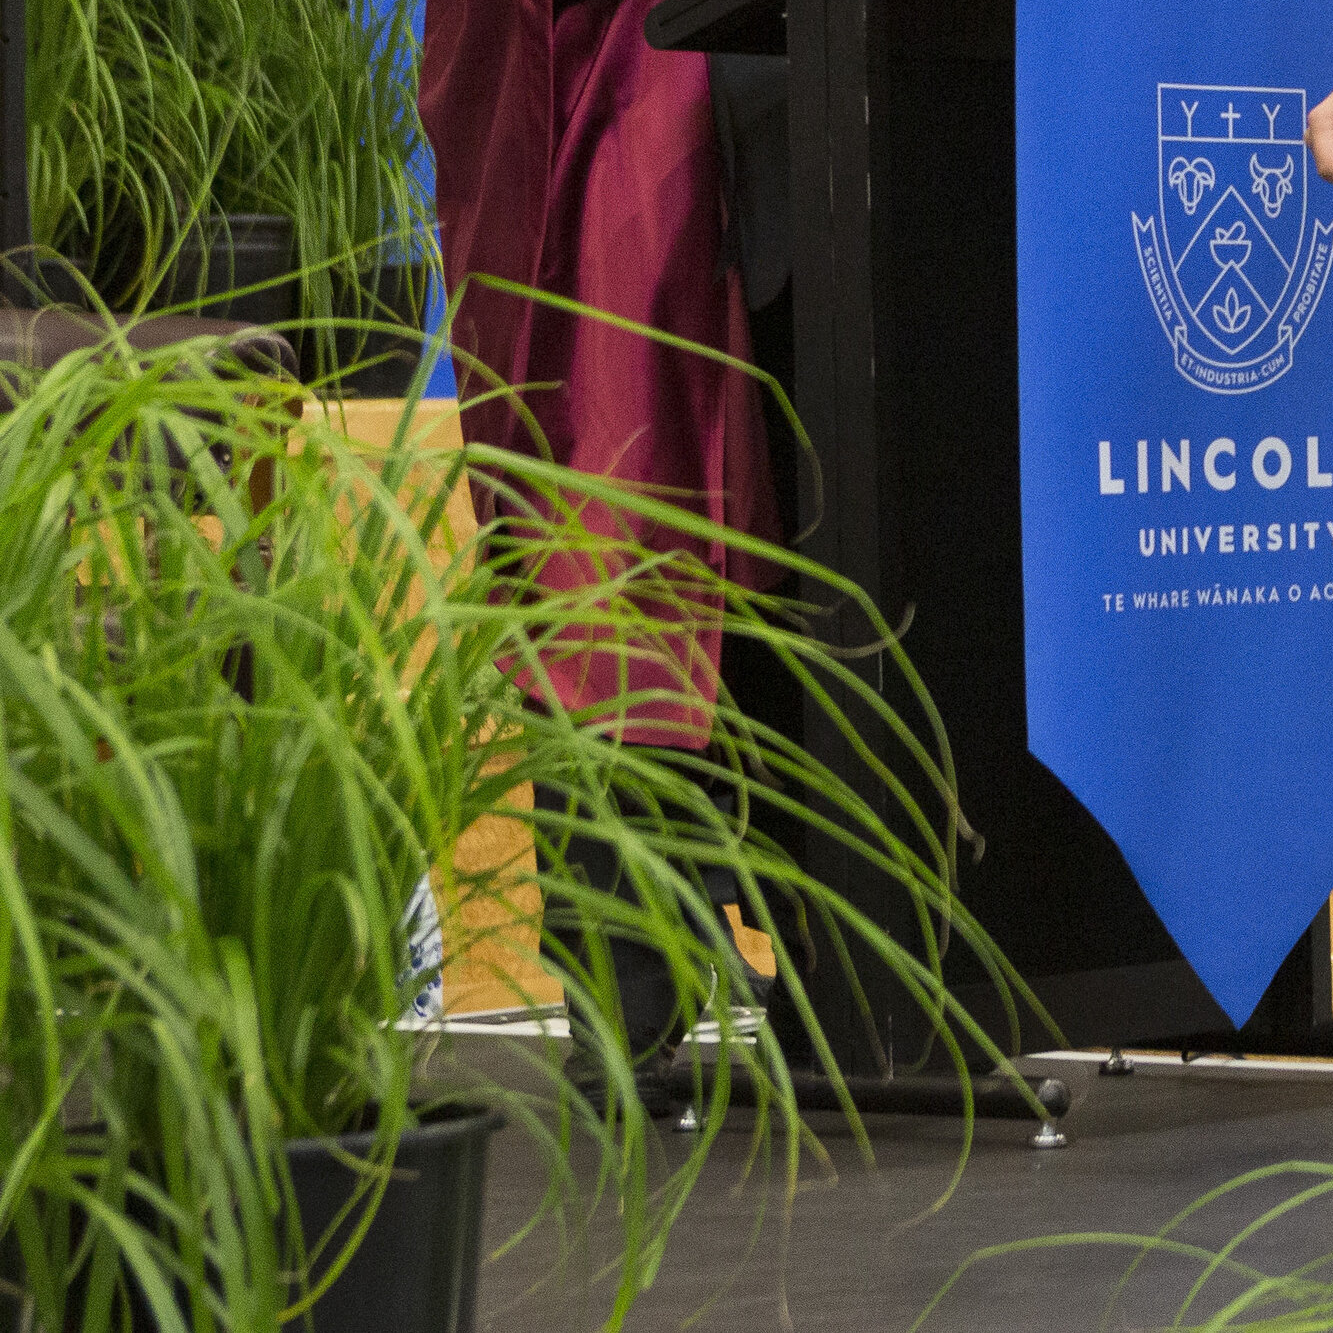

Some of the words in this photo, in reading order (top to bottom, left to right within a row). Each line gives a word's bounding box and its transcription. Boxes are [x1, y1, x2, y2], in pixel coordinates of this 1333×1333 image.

[1102, 593, 1125, 612] TE
[1132, 589, 1190, 610] WHARE
[1288, 584, 1302, 602] O
